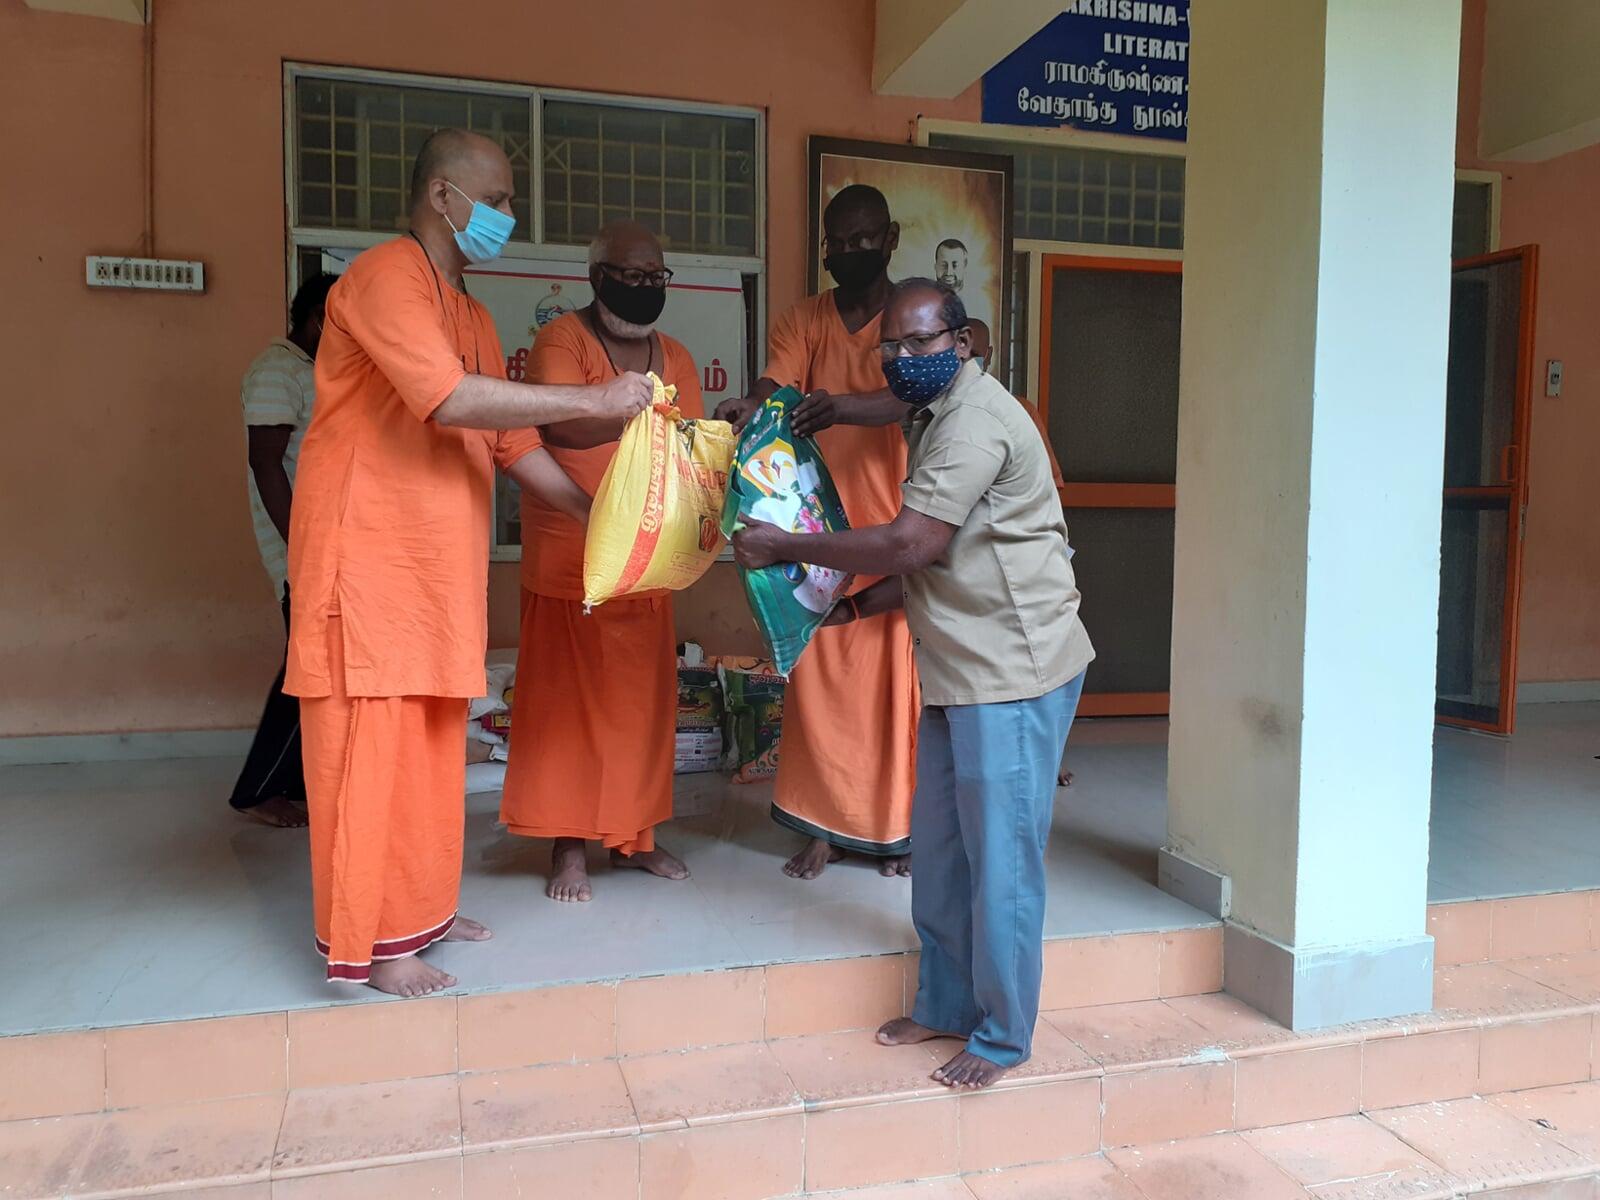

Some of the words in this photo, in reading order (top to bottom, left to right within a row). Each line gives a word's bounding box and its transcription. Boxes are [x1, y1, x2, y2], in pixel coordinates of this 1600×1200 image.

[1064, 0, 1189, 27] KRISHNA-
[1018, 87, 1118, 125] வேதாந்த
[1133, 102, 1188, 131] நூல்
